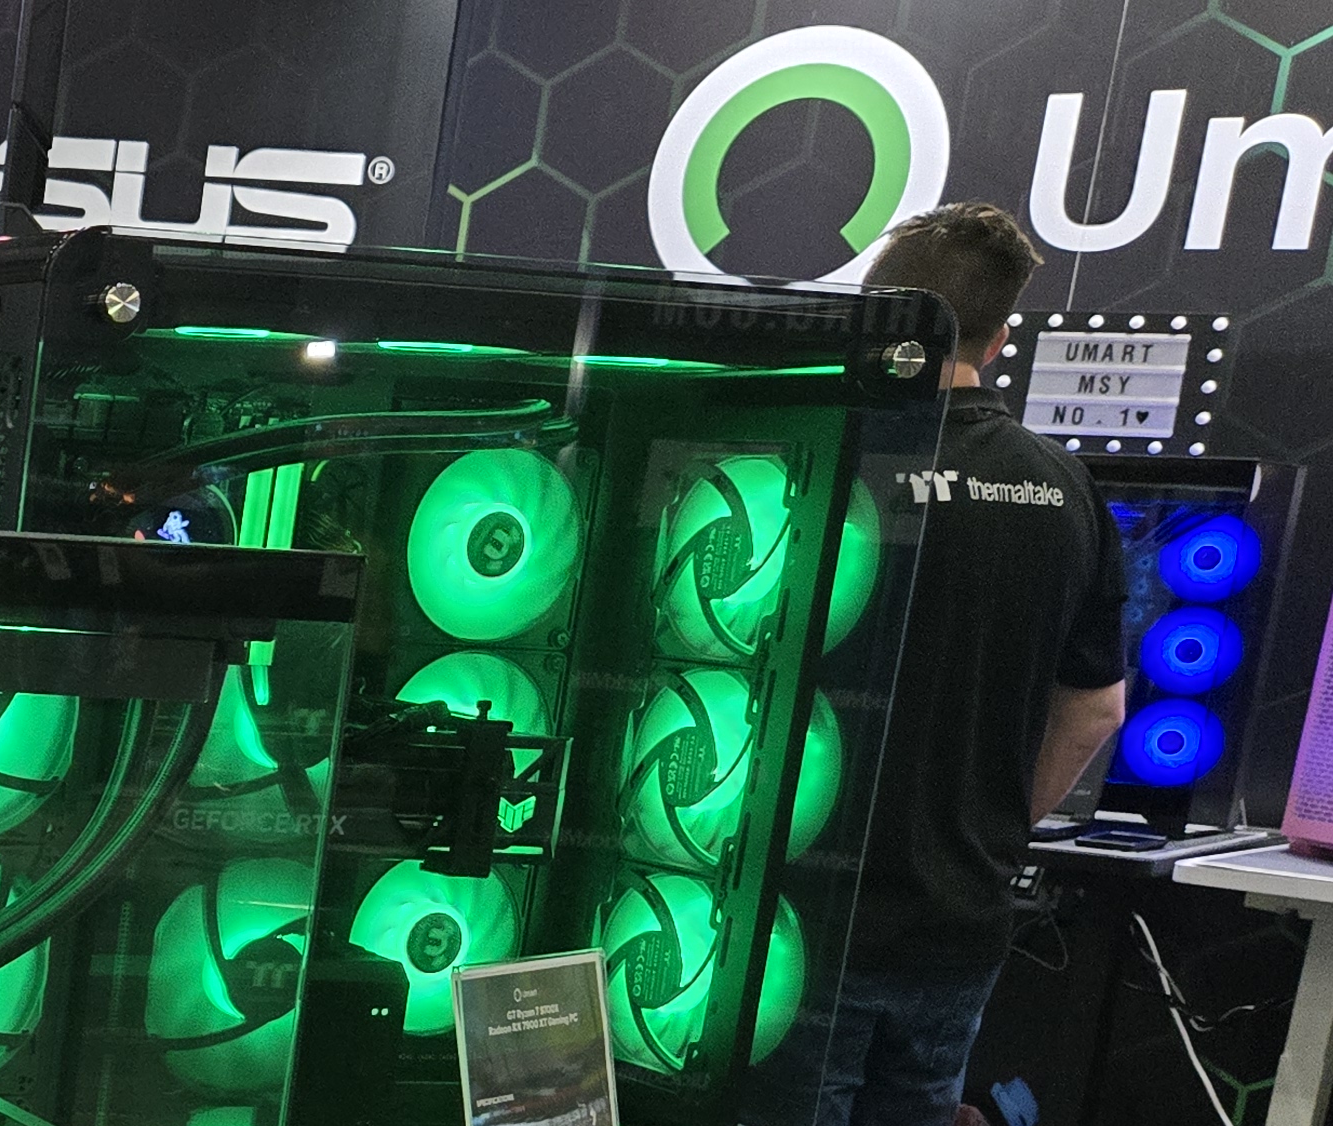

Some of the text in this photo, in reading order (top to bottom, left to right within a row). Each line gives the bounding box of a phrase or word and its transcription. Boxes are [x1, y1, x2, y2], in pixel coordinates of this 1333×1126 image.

[1065, 343, 1154, 363] UMART
[1077, 375, 1131, 394] MSY
[967, 476, 1064, 507] thermaltake
[174, 807, 296, 835] GEFORCE
